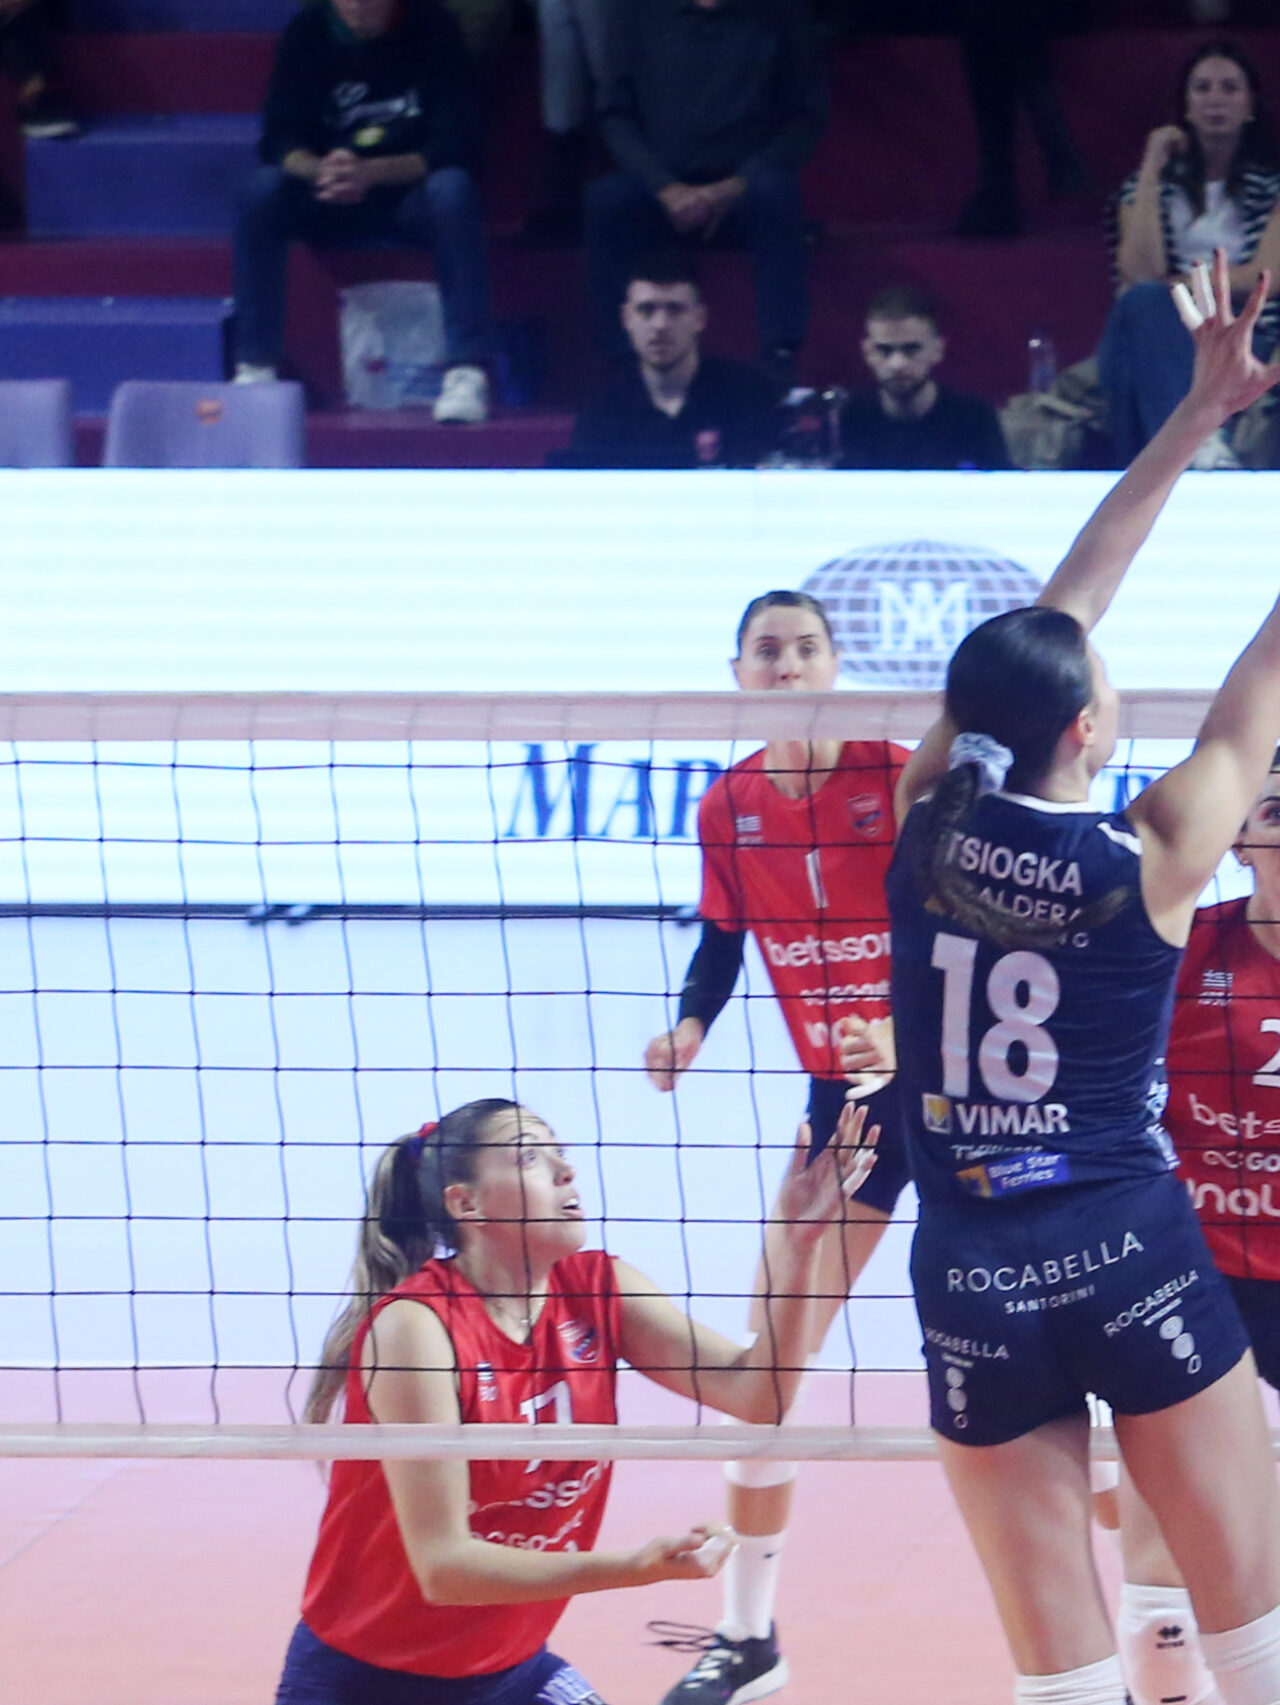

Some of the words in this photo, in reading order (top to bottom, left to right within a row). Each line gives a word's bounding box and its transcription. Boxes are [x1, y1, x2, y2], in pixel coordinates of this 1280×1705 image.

[804, 849, 829, 909] 1
[944, 831, 1083, 897] TSIOGKA
[978, 886, 1083, 926] ALDER
[930, 931, 1061, 1103] 18
[954, 1102, 1071, 1136] VIMAR
[946, 1230, 1144, 1293] ROCABELLA
[1004, 1284, 1096, 1315] SANTORINI
[1102, 1268, 1200, 1339] ROCABELLA
